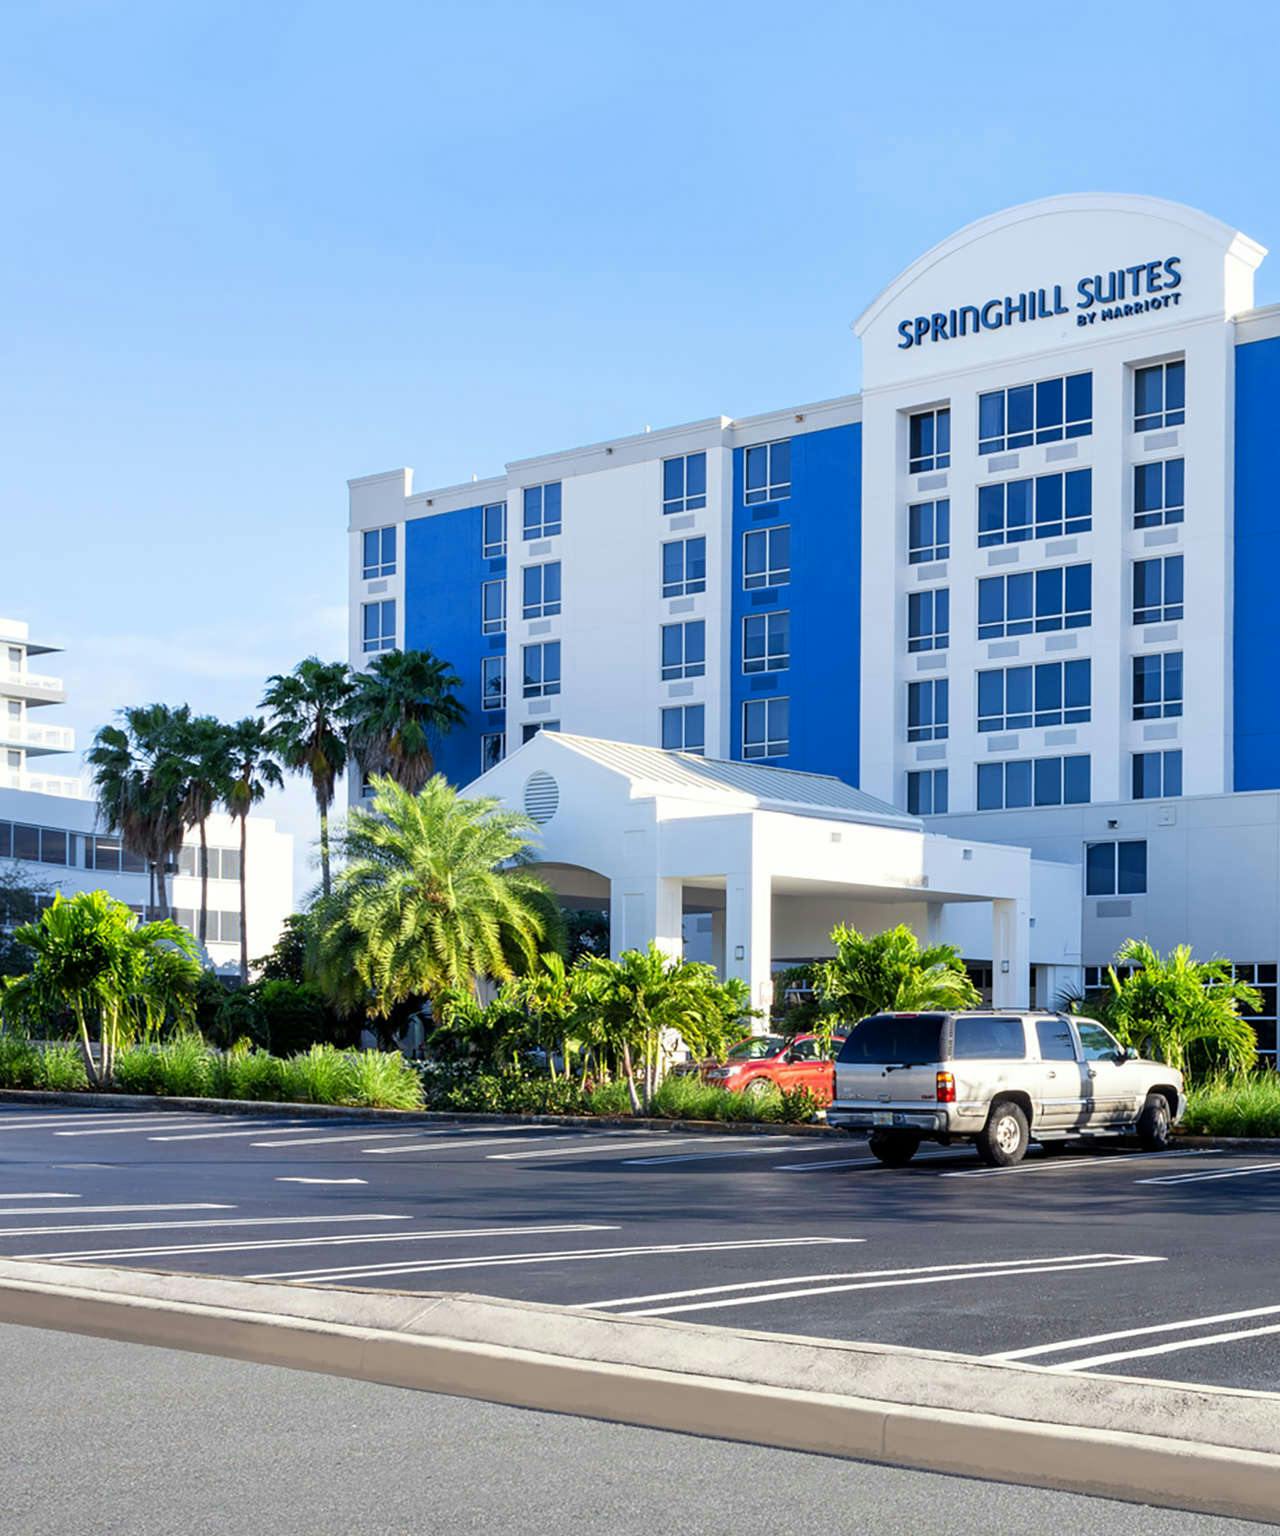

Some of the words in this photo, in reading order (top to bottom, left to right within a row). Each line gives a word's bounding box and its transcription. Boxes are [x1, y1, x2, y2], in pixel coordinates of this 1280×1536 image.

[898, 285, 1069, 349] SPRINGHILL
[1077, 256, 1182, 309] SUITES
[1077, 311, 1097, 327] BY
[1101, 292, 1182, 321] MARRIOTT
